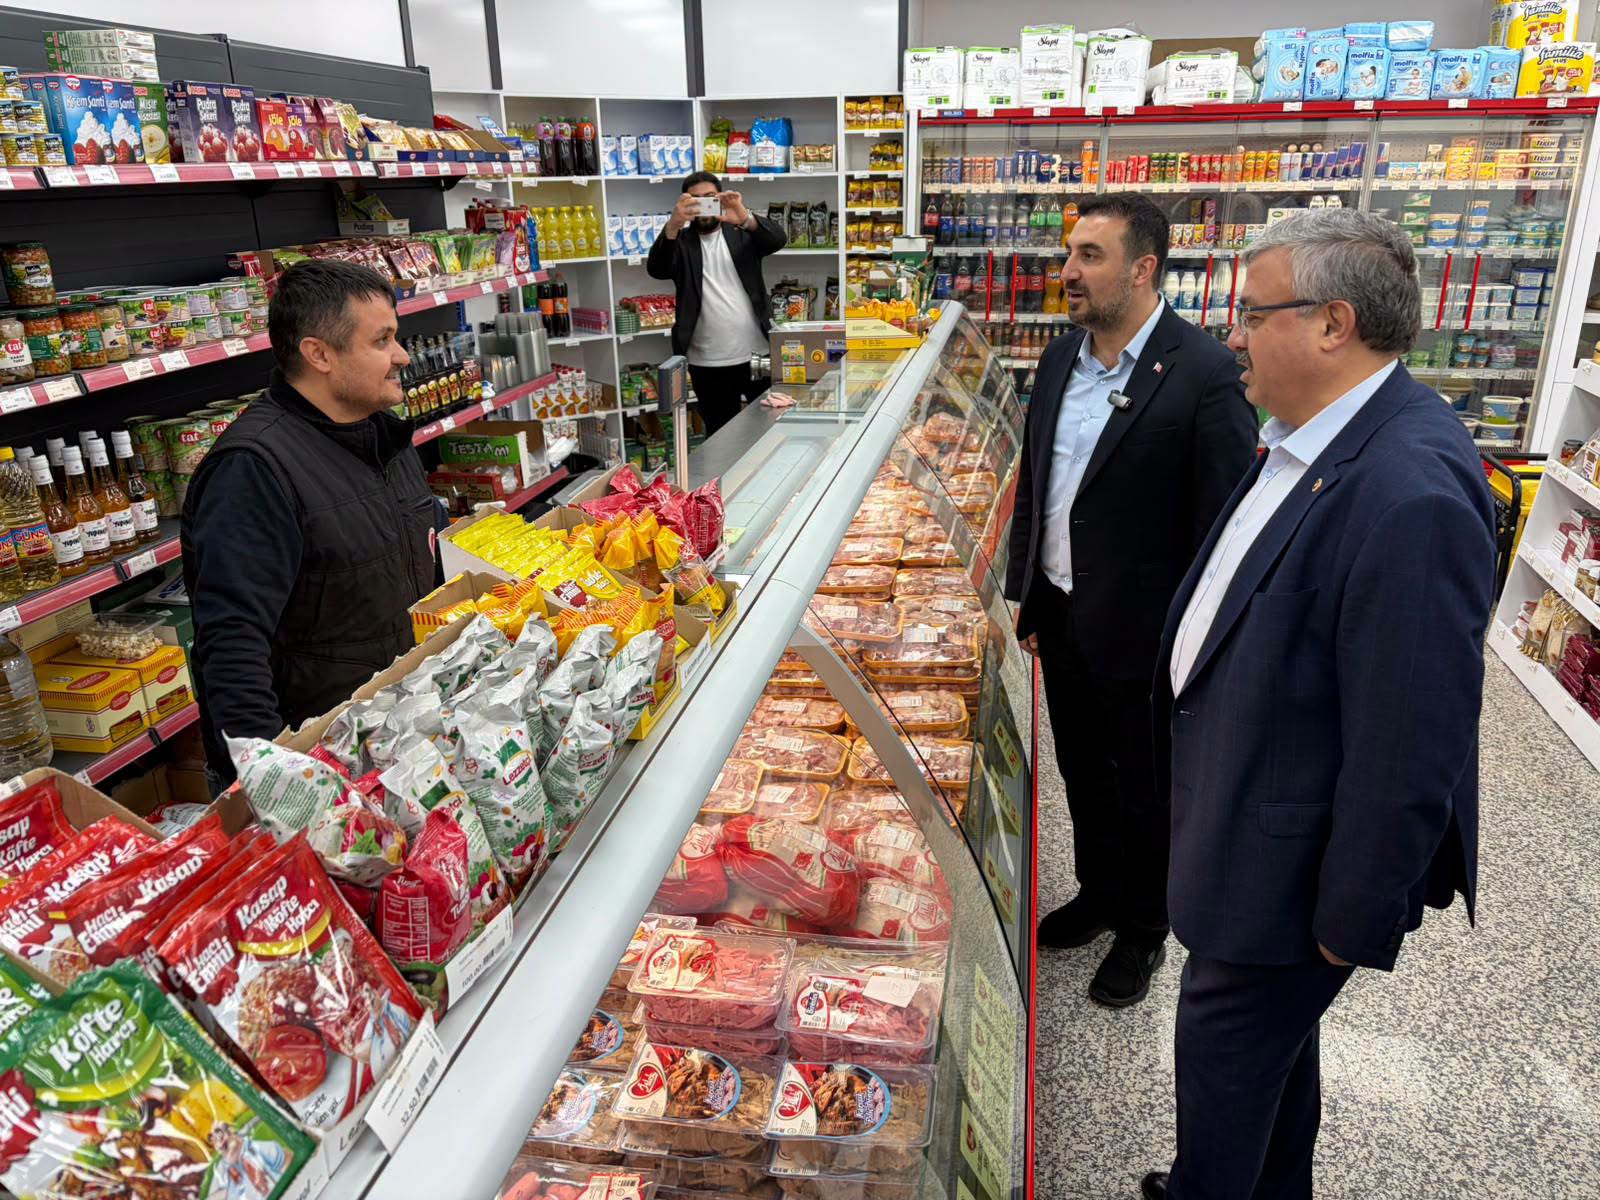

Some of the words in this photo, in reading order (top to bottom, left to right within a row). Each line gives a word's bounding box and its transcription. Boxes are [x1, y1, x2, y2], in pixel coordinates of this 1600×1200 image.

[1441, 55, 1468, 63] molfix
[1537, 45, 1584, 65] familia
[8, 342, 24, 352] tat
[181, 432, 200, 443] tat
[236, 875, 288, 931] Kasap
[50, 998, 124, 1073] Köfte
[89, 1013, 137, 1066] Harcı
